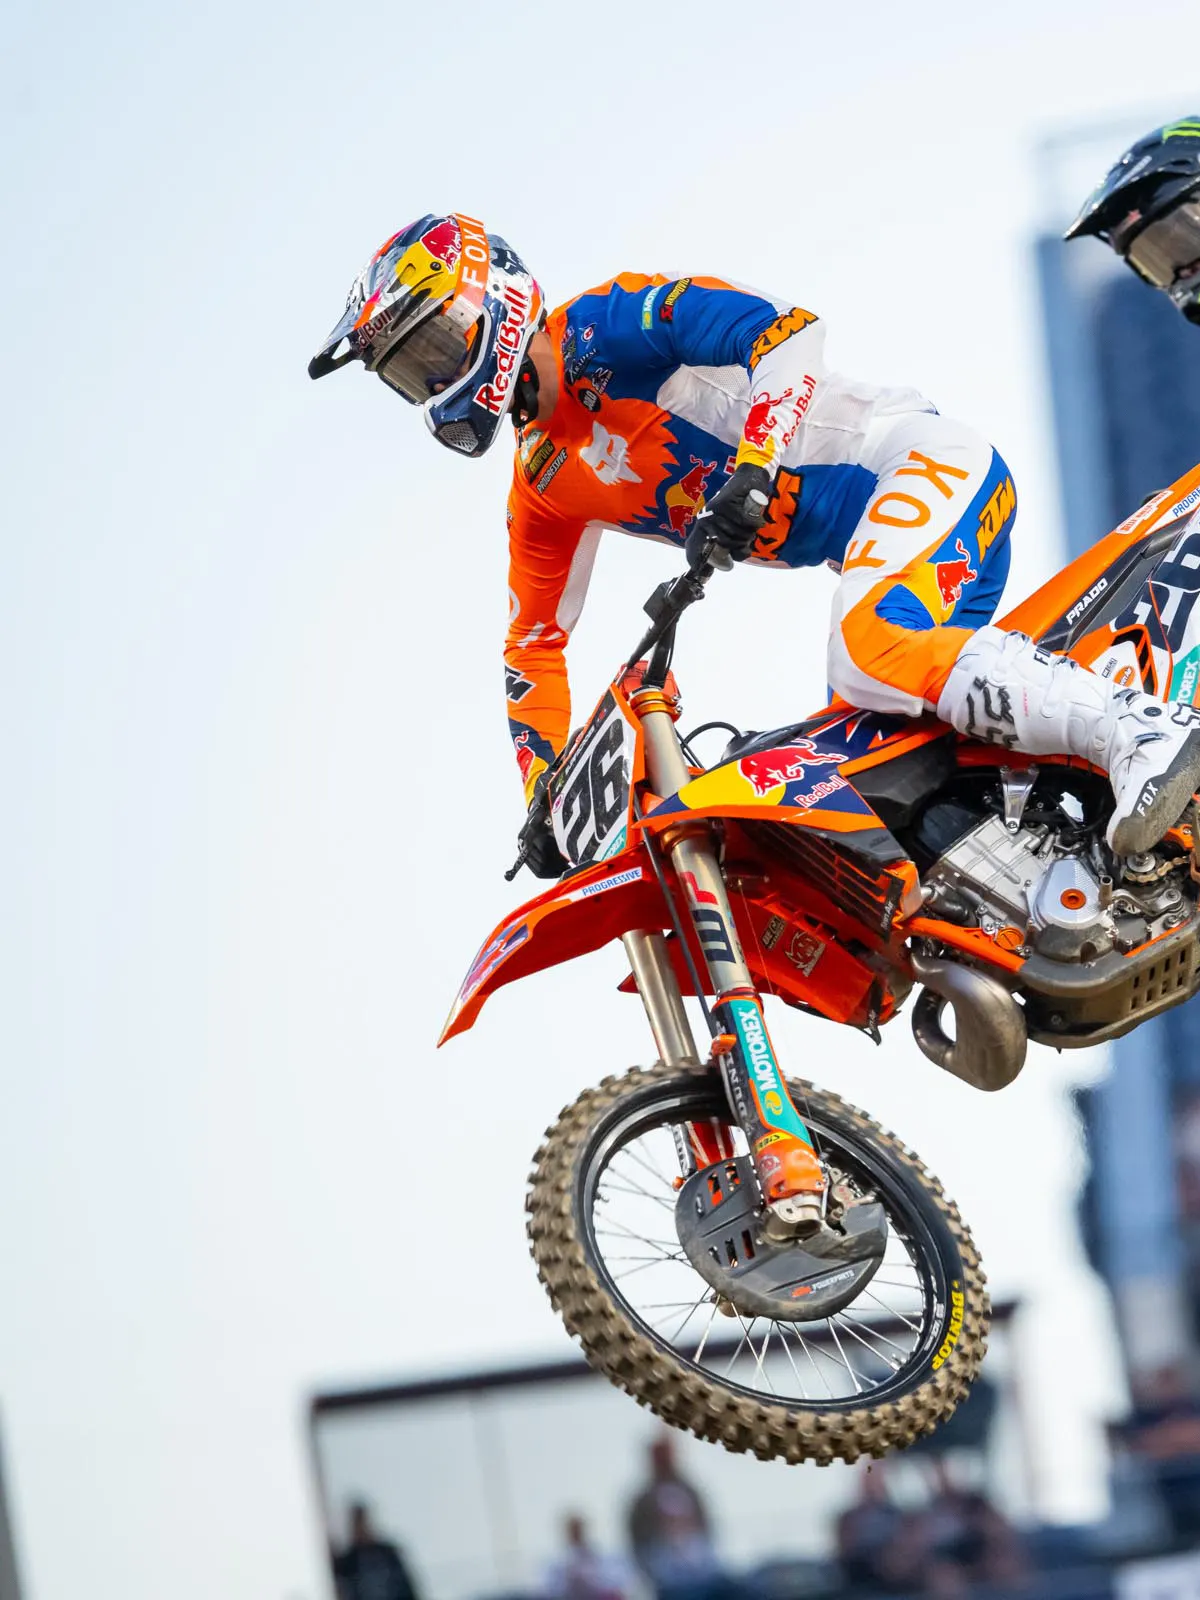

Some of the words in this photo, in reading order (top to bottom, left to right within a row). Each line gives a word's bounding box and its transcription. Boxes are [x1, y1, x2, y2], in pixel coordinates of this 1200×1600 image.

[461, 228, 488, 289] FOX
[749, 307, 819, 371] KTM
[535, 447, 569, 495] PROGRESSIVE
[751, 466, 804, 562] KTM
[842, 450, 970, 574] FOX
[976, 475, 1017, 565] KTM
[1065, 577, 1109, 626] PRADO
[1176, 658, 1199, 705] TOREX
[561, 718, 625, 867] 26
[1136, 780, 1159, 817] FOX
[582, 868, 642, 897] PROGRESSIVE
[715, 1020, 748, 1118] DUNLP
[738, 1006, 779, 1091] MOTOREX
[931, 1290, 965, 1371] DUNLOP
